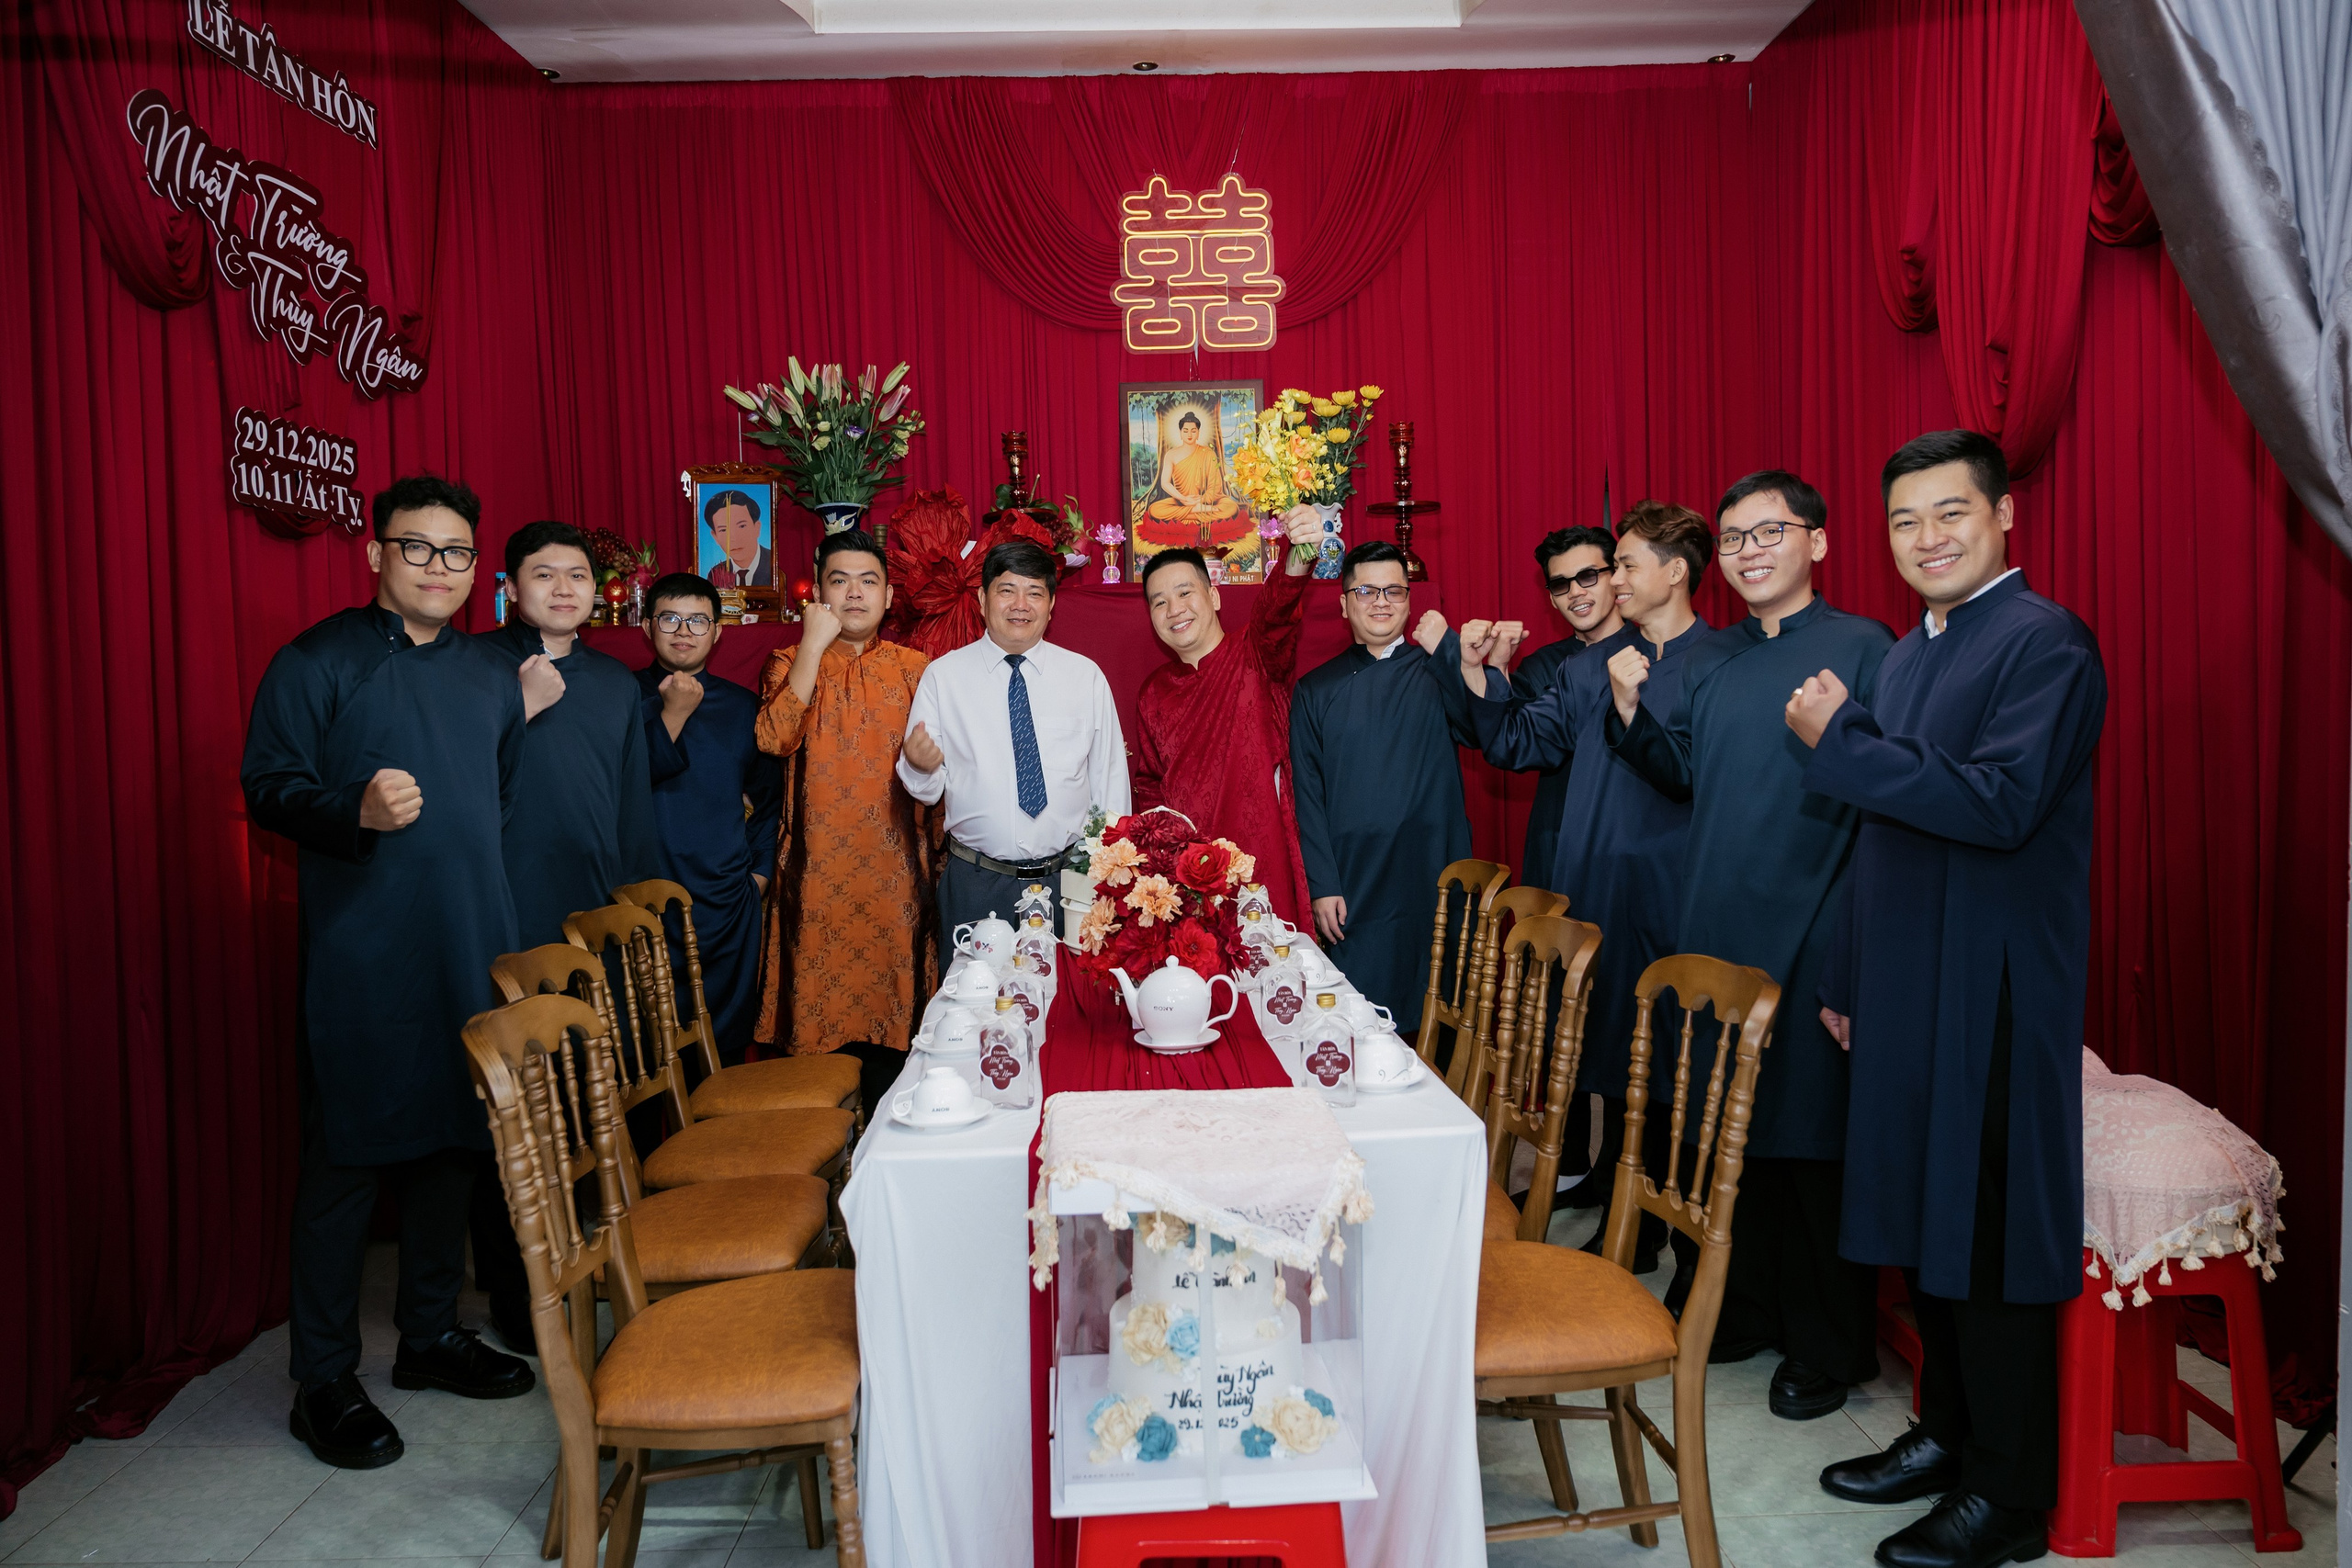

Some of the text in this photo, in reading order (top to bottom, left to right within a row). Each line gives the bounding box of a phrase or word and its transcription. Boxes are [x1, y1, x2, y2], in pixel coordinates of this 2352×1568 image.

[194, 0, 377, 142] LỄ TÂN HÔN
[137, 104, 362, 289] Nhật Trường
[225, 234, 247, 275] &
[248, 251, 424, 388] Thùy Ngân
[242, 416, 355, 476] 29.12.2025
[237, 462, 295, 504] 10.11
[1164, 1388, 1203, 1413] Nhậ
